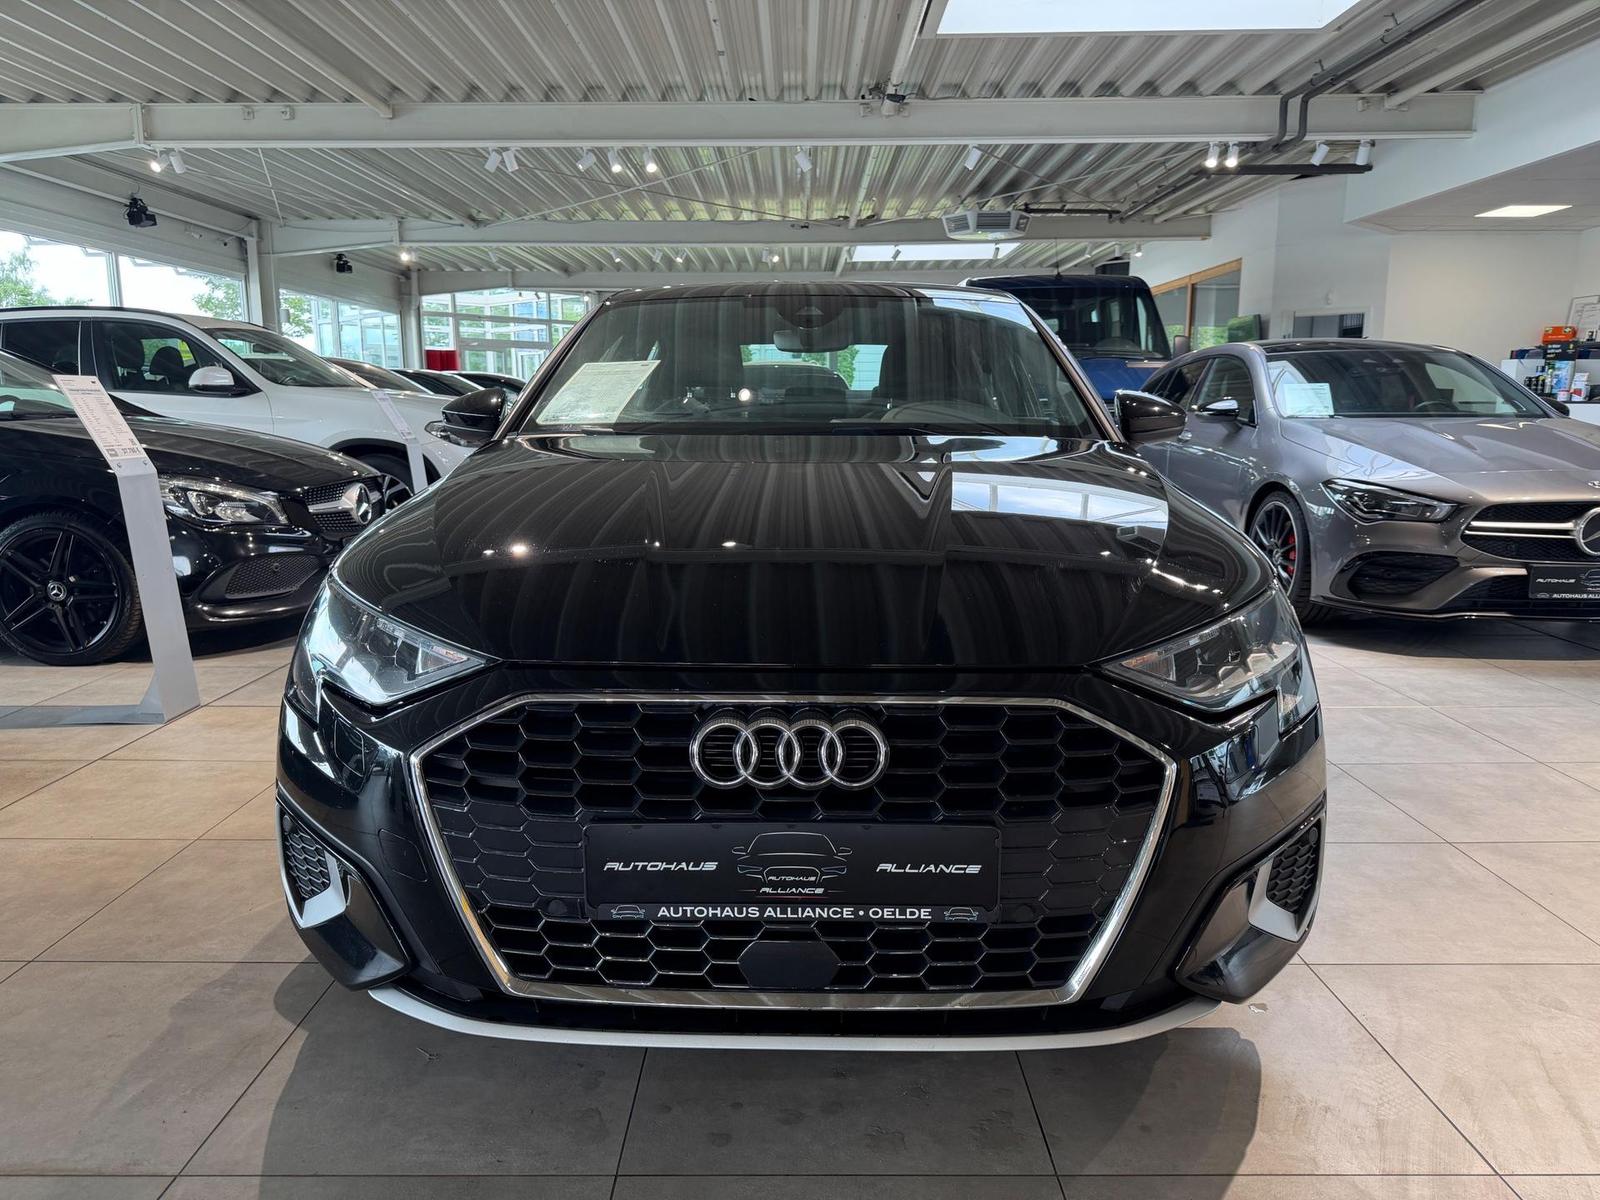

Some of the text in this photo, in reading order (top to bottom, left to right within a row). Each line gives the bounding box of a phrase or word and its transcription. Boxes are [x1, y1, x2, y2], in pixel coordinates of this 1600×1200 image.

[603, 861, 719, 871] AUTOHAUS
[876, 863, 982, 874] ALLIANCE
[657, 906, 932, 919] AUTOHAUS ALLIANCE OELDE
